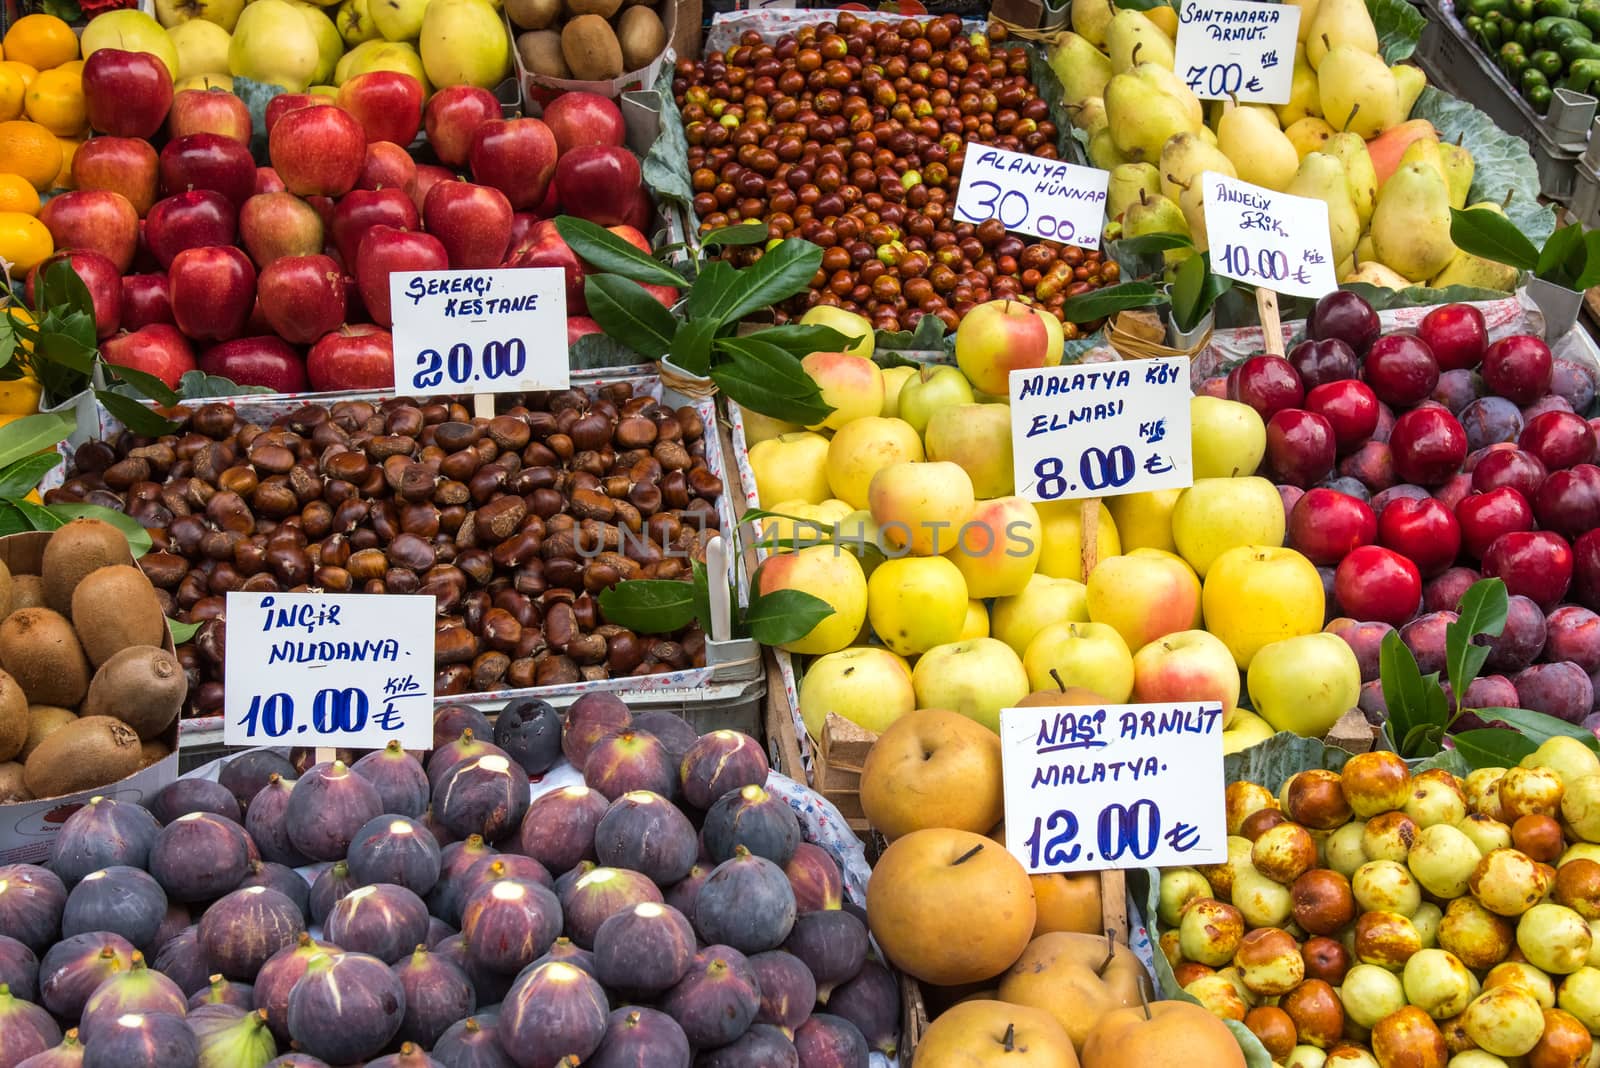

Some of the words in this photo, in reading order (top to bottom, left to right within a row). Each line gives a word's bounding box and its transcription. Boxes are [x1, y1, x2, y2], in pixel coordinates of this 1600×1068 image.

[977, 151, 1067, 179] ALANYA
[1035, 180, 1106, 204] HÜNNAP
[444, 295, 539, 318] KESTANE
[413, 338, 527, 389] 20.00
[1019, 370, 1131, 400] MALATYA
[1026, 399, 1124, 438] ELMASI
[1034, 445, 1136, 500] 8.00
[237, 688, 369, 737] 10.00
[1119, 706, 1222, 740] ARMUT
[1024, 799, 1161, 868] 12.00
